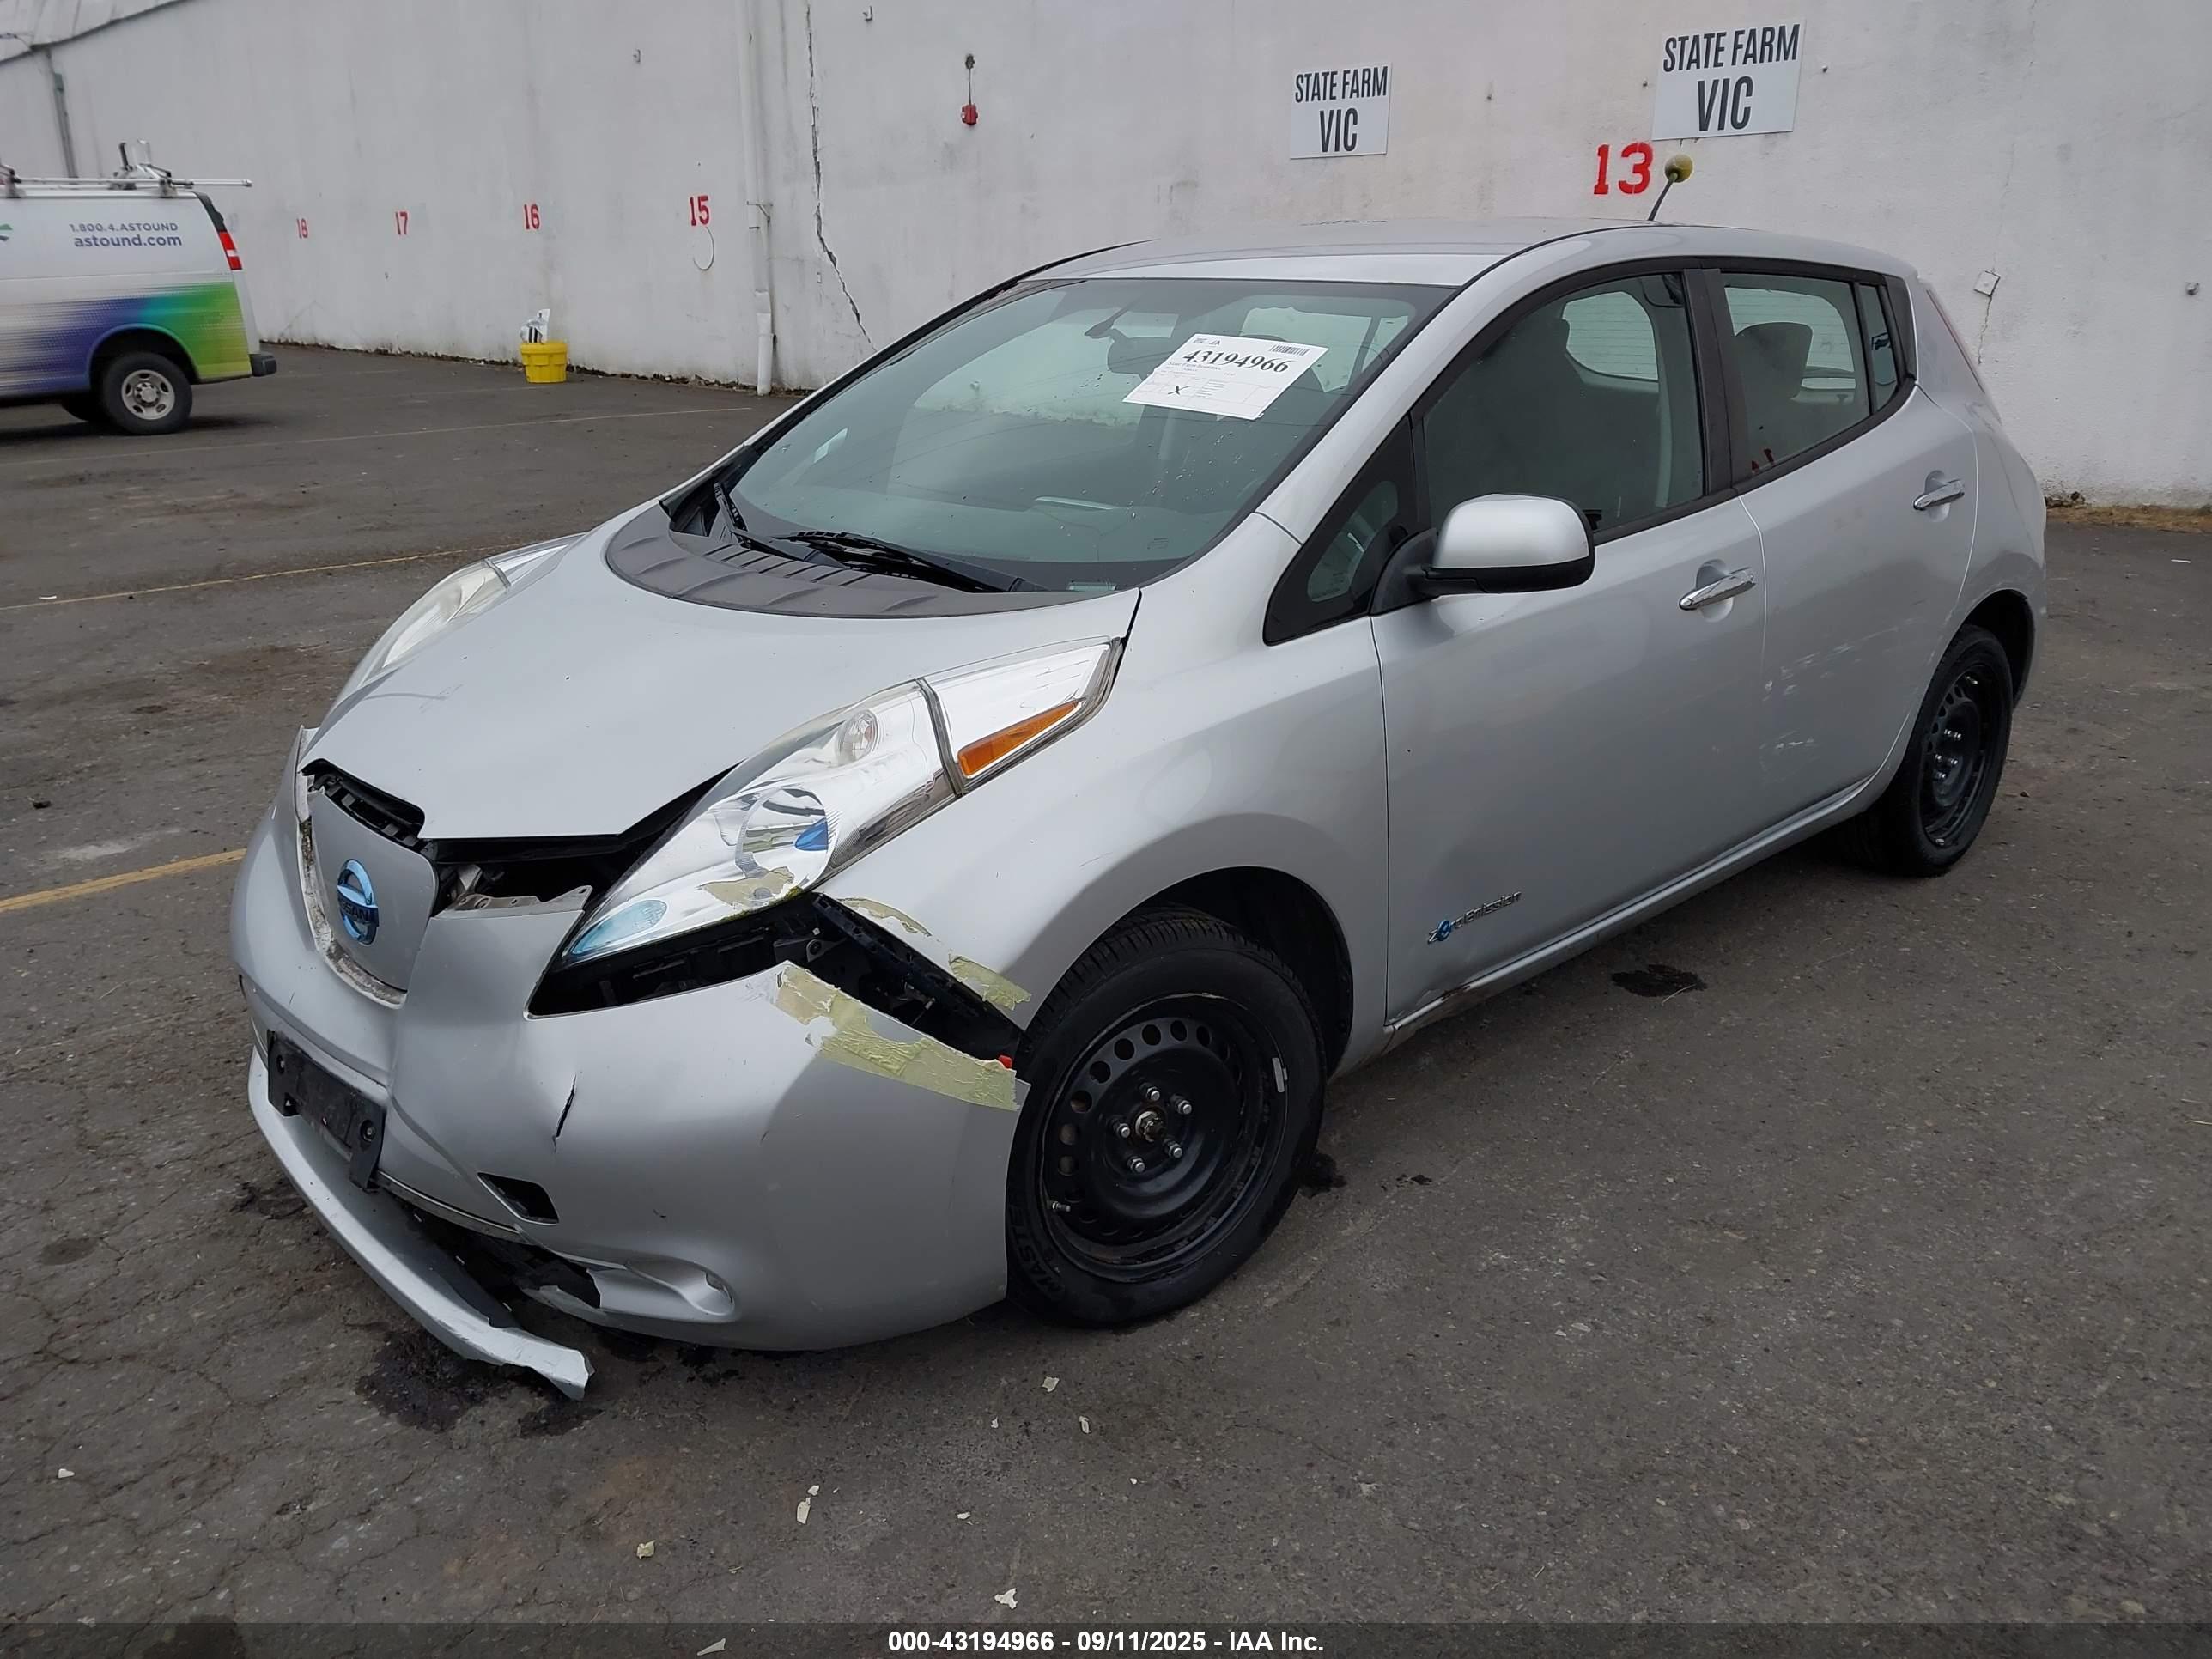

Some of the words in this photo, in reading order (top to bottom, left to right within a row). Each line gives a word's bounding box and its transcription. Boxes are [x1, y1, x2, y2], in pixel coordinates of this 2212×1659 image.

[1663, 32, 1727, 72] STATE
[1731, 23, 1801, 66] FARM
[1295, 70, 1338, 103] STATE
[1341, 66, 1388, 99] FARM
[1698, 76, 1753, 131] VIC
[1320, 107, 1358, 153] VIC
[1594, 142, 1654, 195] 13
[395, 210, 408, 235] 17
[523, 204, 540, 230] 16
[690, 195, 710, 227] 15
[70, 222, 179, 232] 1.800.4.ASTOUND
[74, 234, 182, 247] astound.com
[296, 217, 308, 239] 18
[1182, 349, 1295, 373] 43194966
